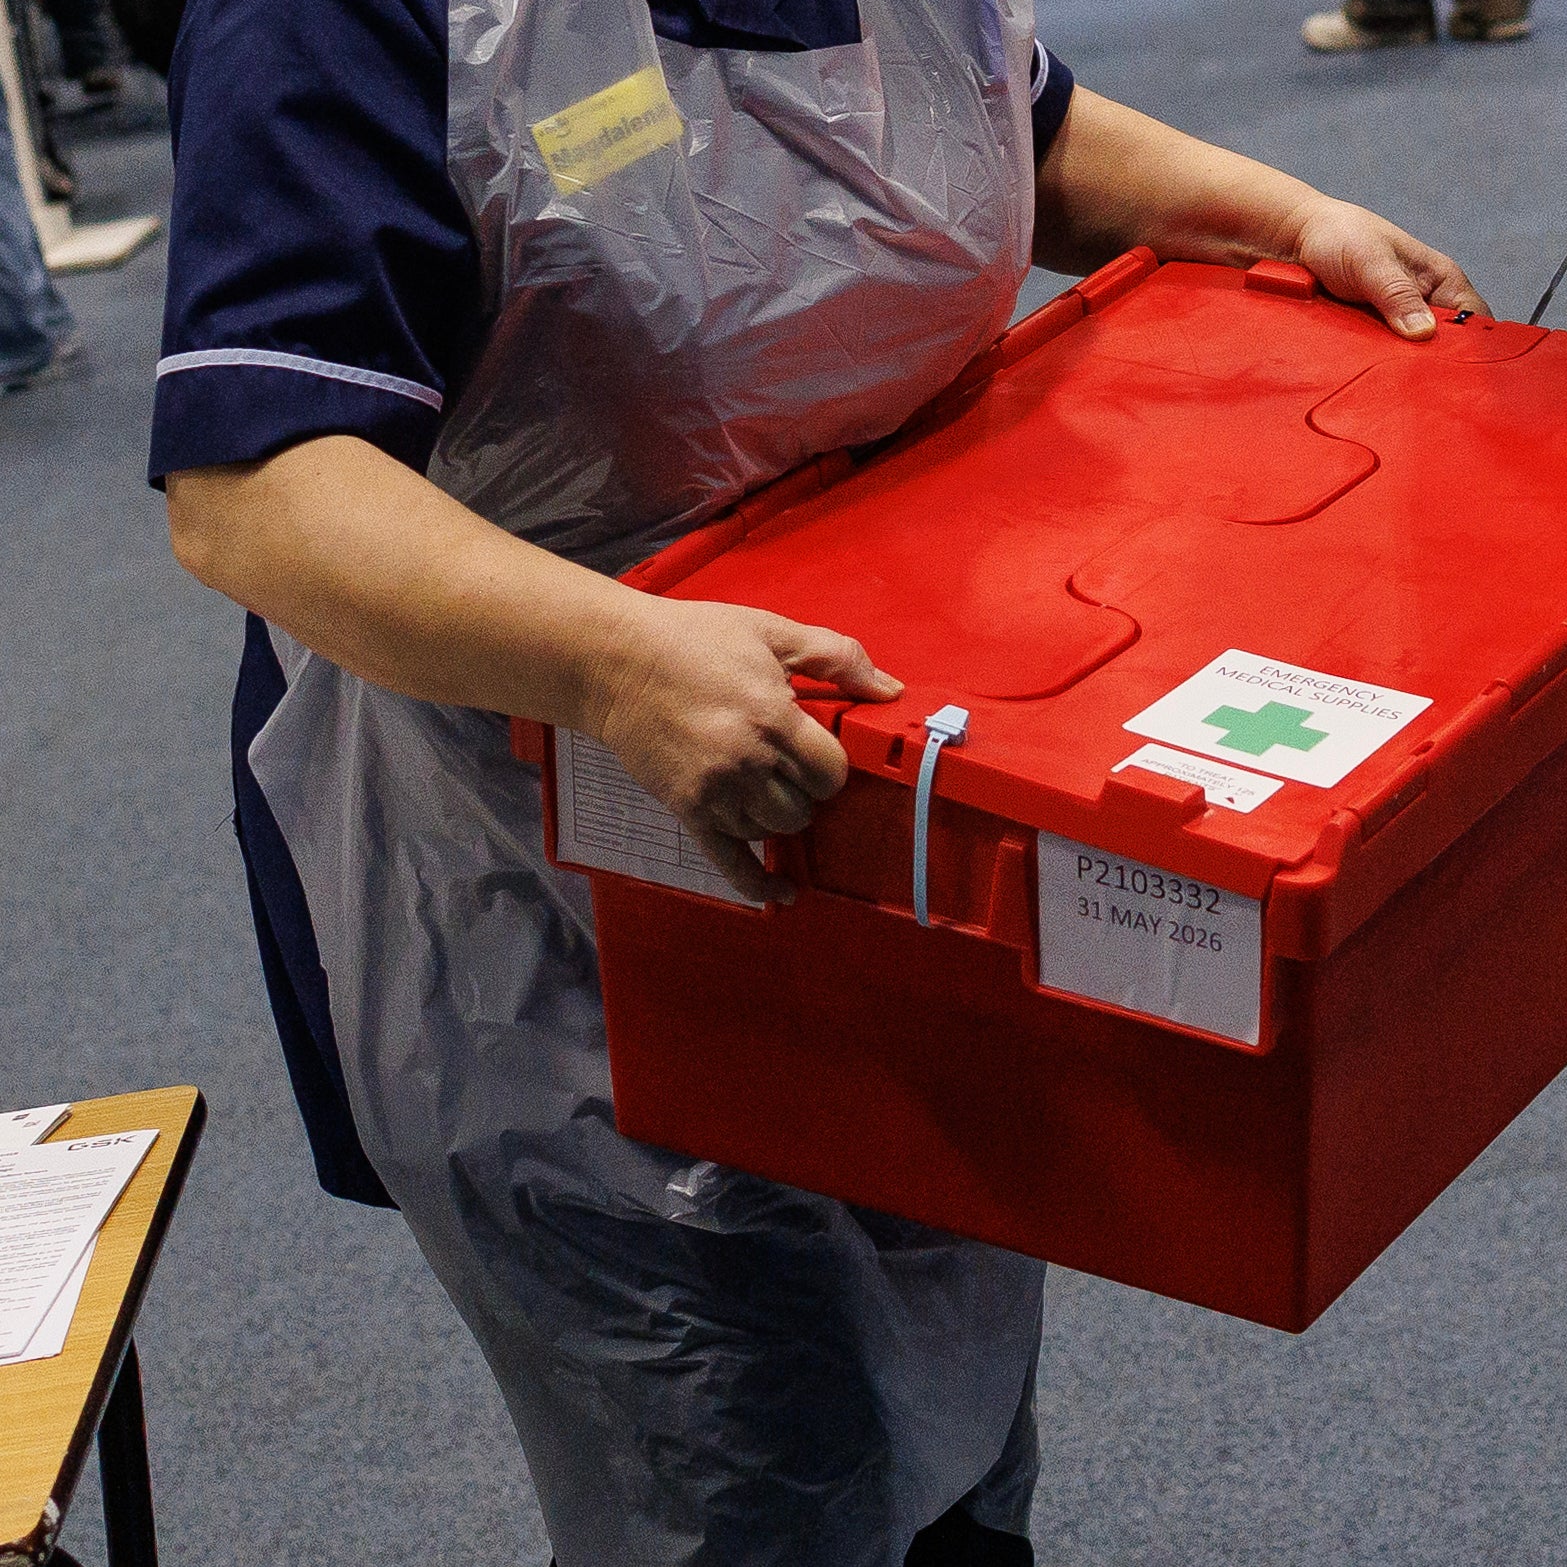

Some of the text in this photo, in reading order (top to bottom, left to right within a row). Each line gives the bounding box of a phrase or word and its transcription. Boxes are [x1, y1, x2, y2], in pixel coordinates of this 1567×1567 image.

[1215, 666, 1403, 720] MEDICAL SUPPLIES
[1259, 665, 1384, 701] EMERGENCY
[1076, 855, 1222, 916] P2103332
[1076, 896, 1224, 953] 31 MAY 2026
[67, 1134, 137, 1151] GSK
